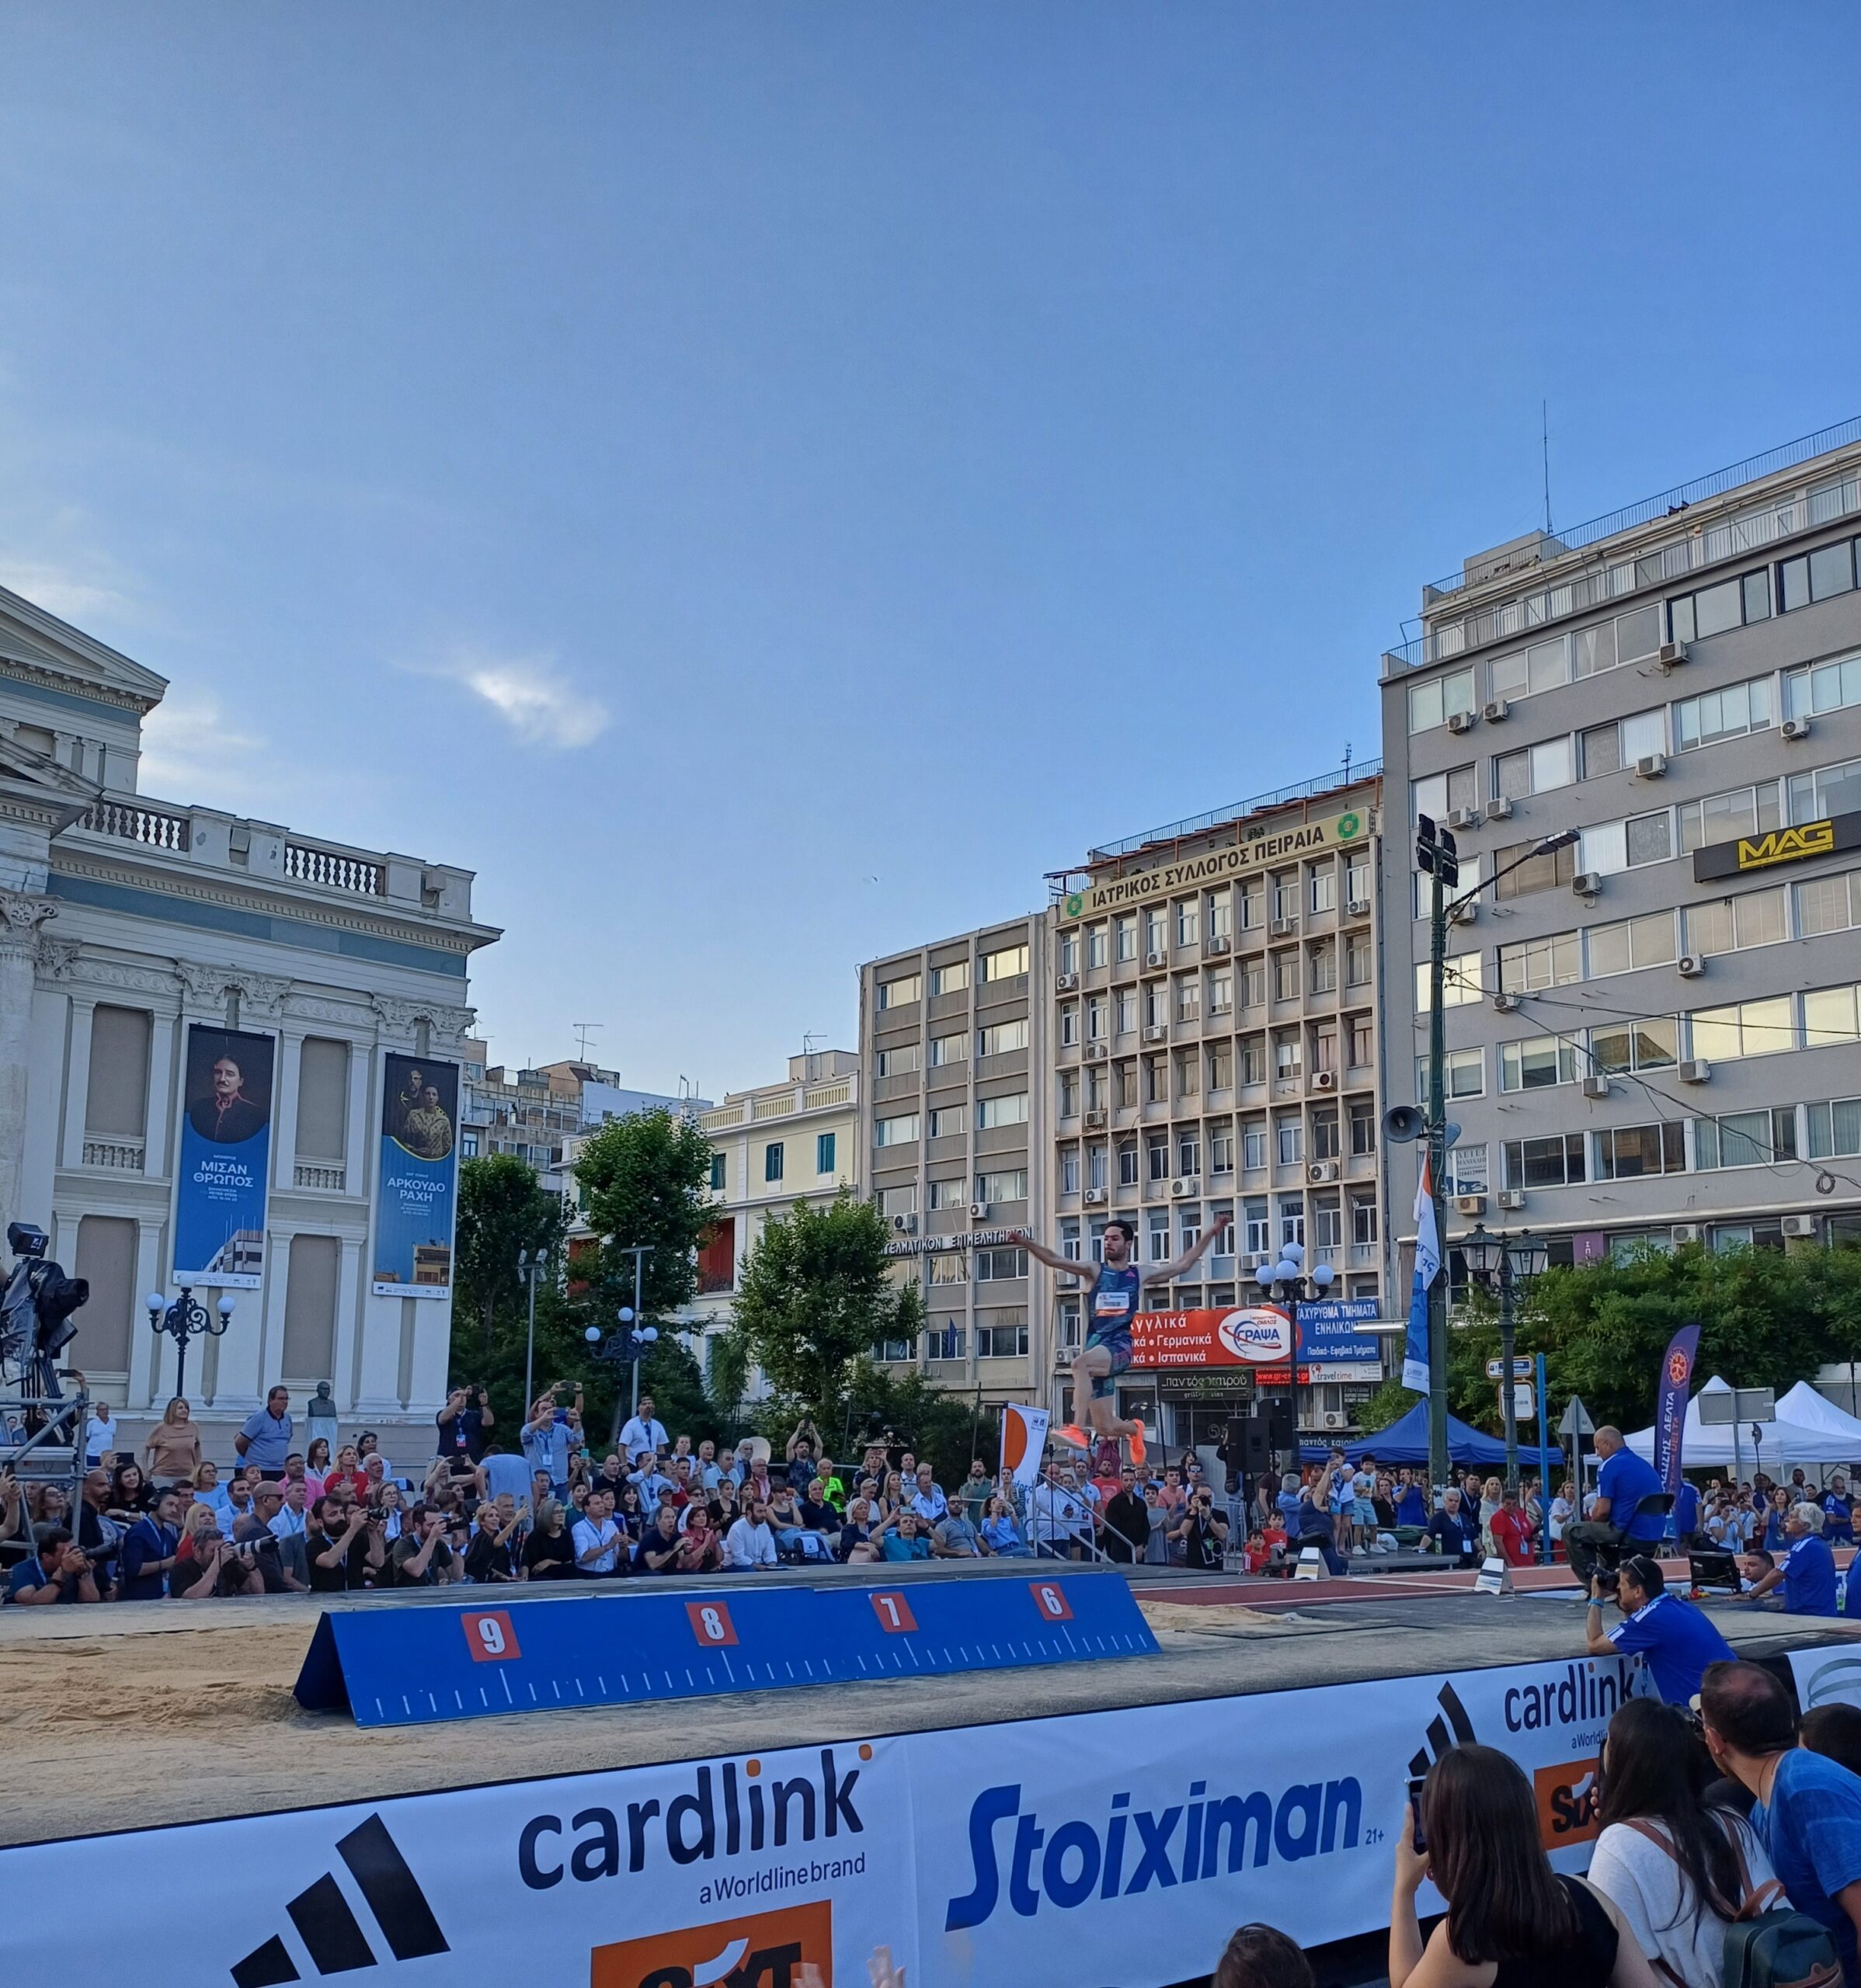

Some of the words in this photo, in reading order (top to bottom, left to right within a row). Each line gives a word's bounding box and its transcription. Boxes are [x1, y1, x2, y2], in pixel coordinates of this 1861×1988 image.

[1738, 820, 1833, 862] MAG
[1093, 874, 1160, 907] ΙΑΤΡΙΚΟΣ
[1165, 848, 1249, 886] ΣΥΛΛΟΓΟΣ
[1254, 826, 1324, 861] ΠΕΙΡΑΙΑ
[201, 1160, 247, 1175] ΜΙΣΑΝ
[193, 1172, 253, 1187] ΘΡΩΠΟΣ
[387, 1177, 446, 1193] ΑΡΚΟΥΔΟ
[400, 1190, 433, 1202] ΡΑΧΗ
[1341, 1304, 1376, 1318] ΤΜΗΜΑΤΑ
[1157, 1333, 1212, 1350] Γερμανικά
[1237, 1328, 1281, 1342] ΓΡΑΨΑ
[1158, 1350, 1206, 1364] Ισπανικά
[1041, 1587, 1063, 1615] 6
[701, 1607, 725, 1640] 8
[478, 1618, 506, 1653] 9
[1505, 1656, 1640, 1733] cardlink
[519, 1743, 872, 1890] cardlink
[944, 1775, 1362, 1932] Stoiximan
[1365, 1828, 1384, 1845] 21+
